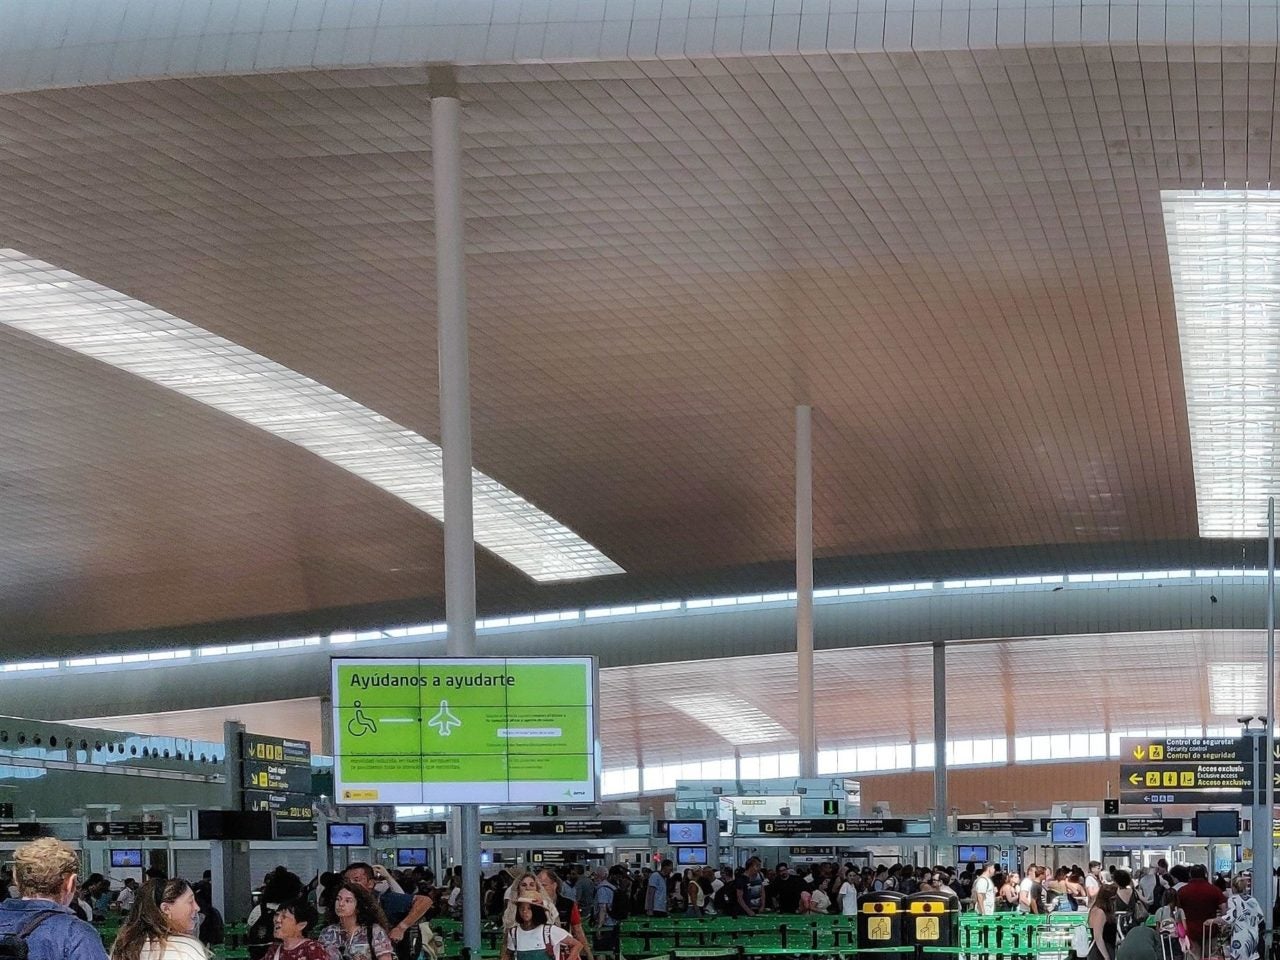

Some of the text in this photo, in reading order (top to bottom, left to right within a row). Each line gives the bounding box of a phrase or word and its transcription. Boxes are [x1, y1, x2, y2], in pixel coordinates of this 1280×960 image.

[350, 673, 516, 689] Ayúdanos a ayudarte
[1202, 752, 1236, 760] seguridad
